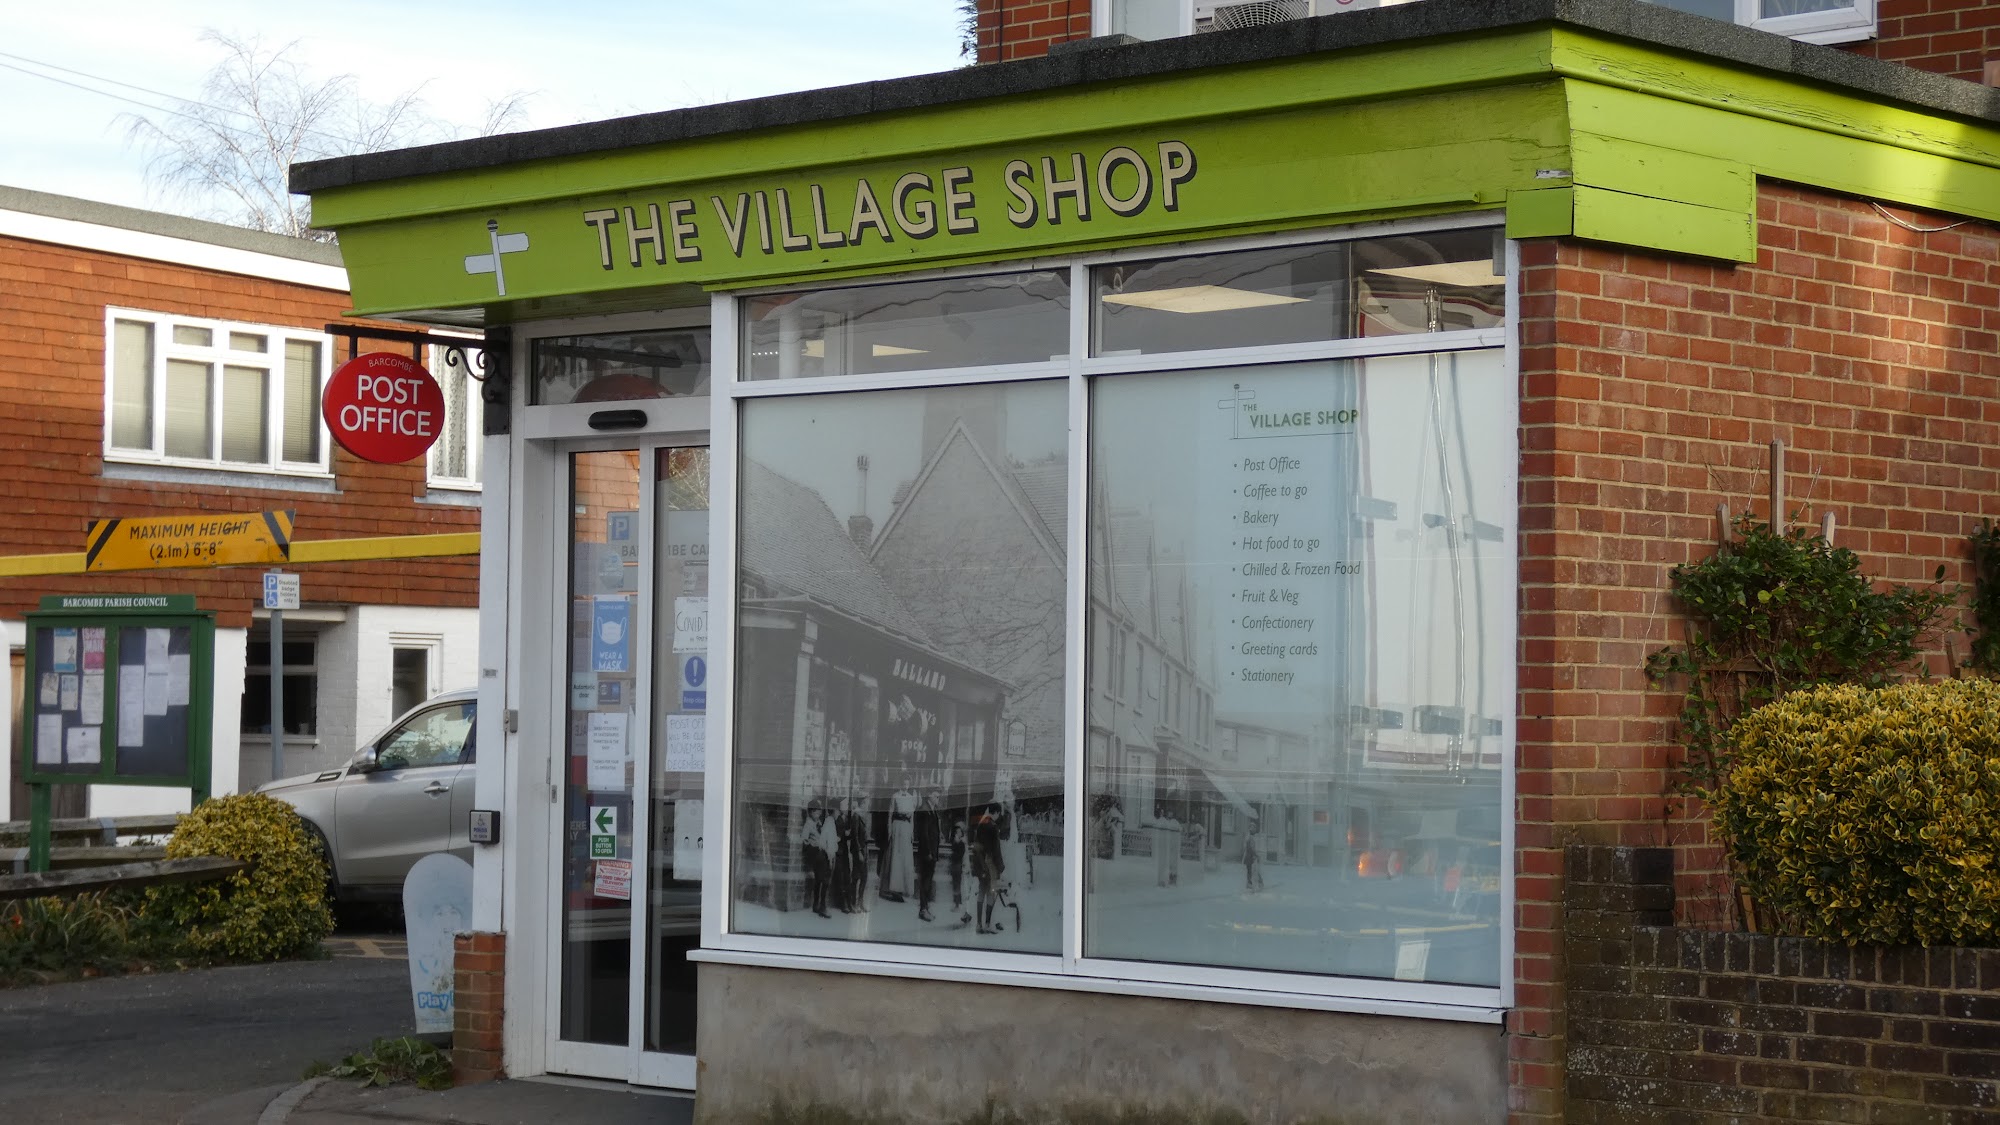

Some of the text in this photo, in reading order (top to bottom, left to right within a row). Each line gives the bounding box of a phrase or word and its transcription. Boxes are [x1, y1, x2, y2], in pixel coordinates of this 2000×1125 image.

[584, 140, 1198, 270] THE VILLAGE SHOP
[368, 358, 414, 373] BARCOMBE
[358, 374, 424, 405] POST
[340, 404, 431, 436] OFFICE
[1250, 409, 1358, 429] VILLAGE SHOP
[1243, 456, 1300, 473] Post Office
[1243, 483, 1308, 500] Coffee to go
[1243, 510, 1279, 527] Bakery
[130, 520, 250, 539] MAXIMUM HEIGHT
[1242, 536, 1320, 552] Hot food to go
[1242, 560, 1361, 576] Chilled & Frozen Food
[269, 577, 276, 588] P
[63, 597, 168, 607] BARCOMBE PARISH COUNCIL
[1241, 588, 1299, 606] Fruit & Veg
[1241, 615, 1315, 632] Confectionery
[600, 652, 616, 660] WEAR
[1241, 641, 1318, 659] Greeting cards
[598, 660, 622, 670] MASK
[1241, 667, 1295, 685] Stationery
[692, 717, 705, 729] OFF
[670, 742, 705, 754] NOVEMBE
[601, 861, 630, 869] WARNING
[418, 991, 450, 1011] Play
